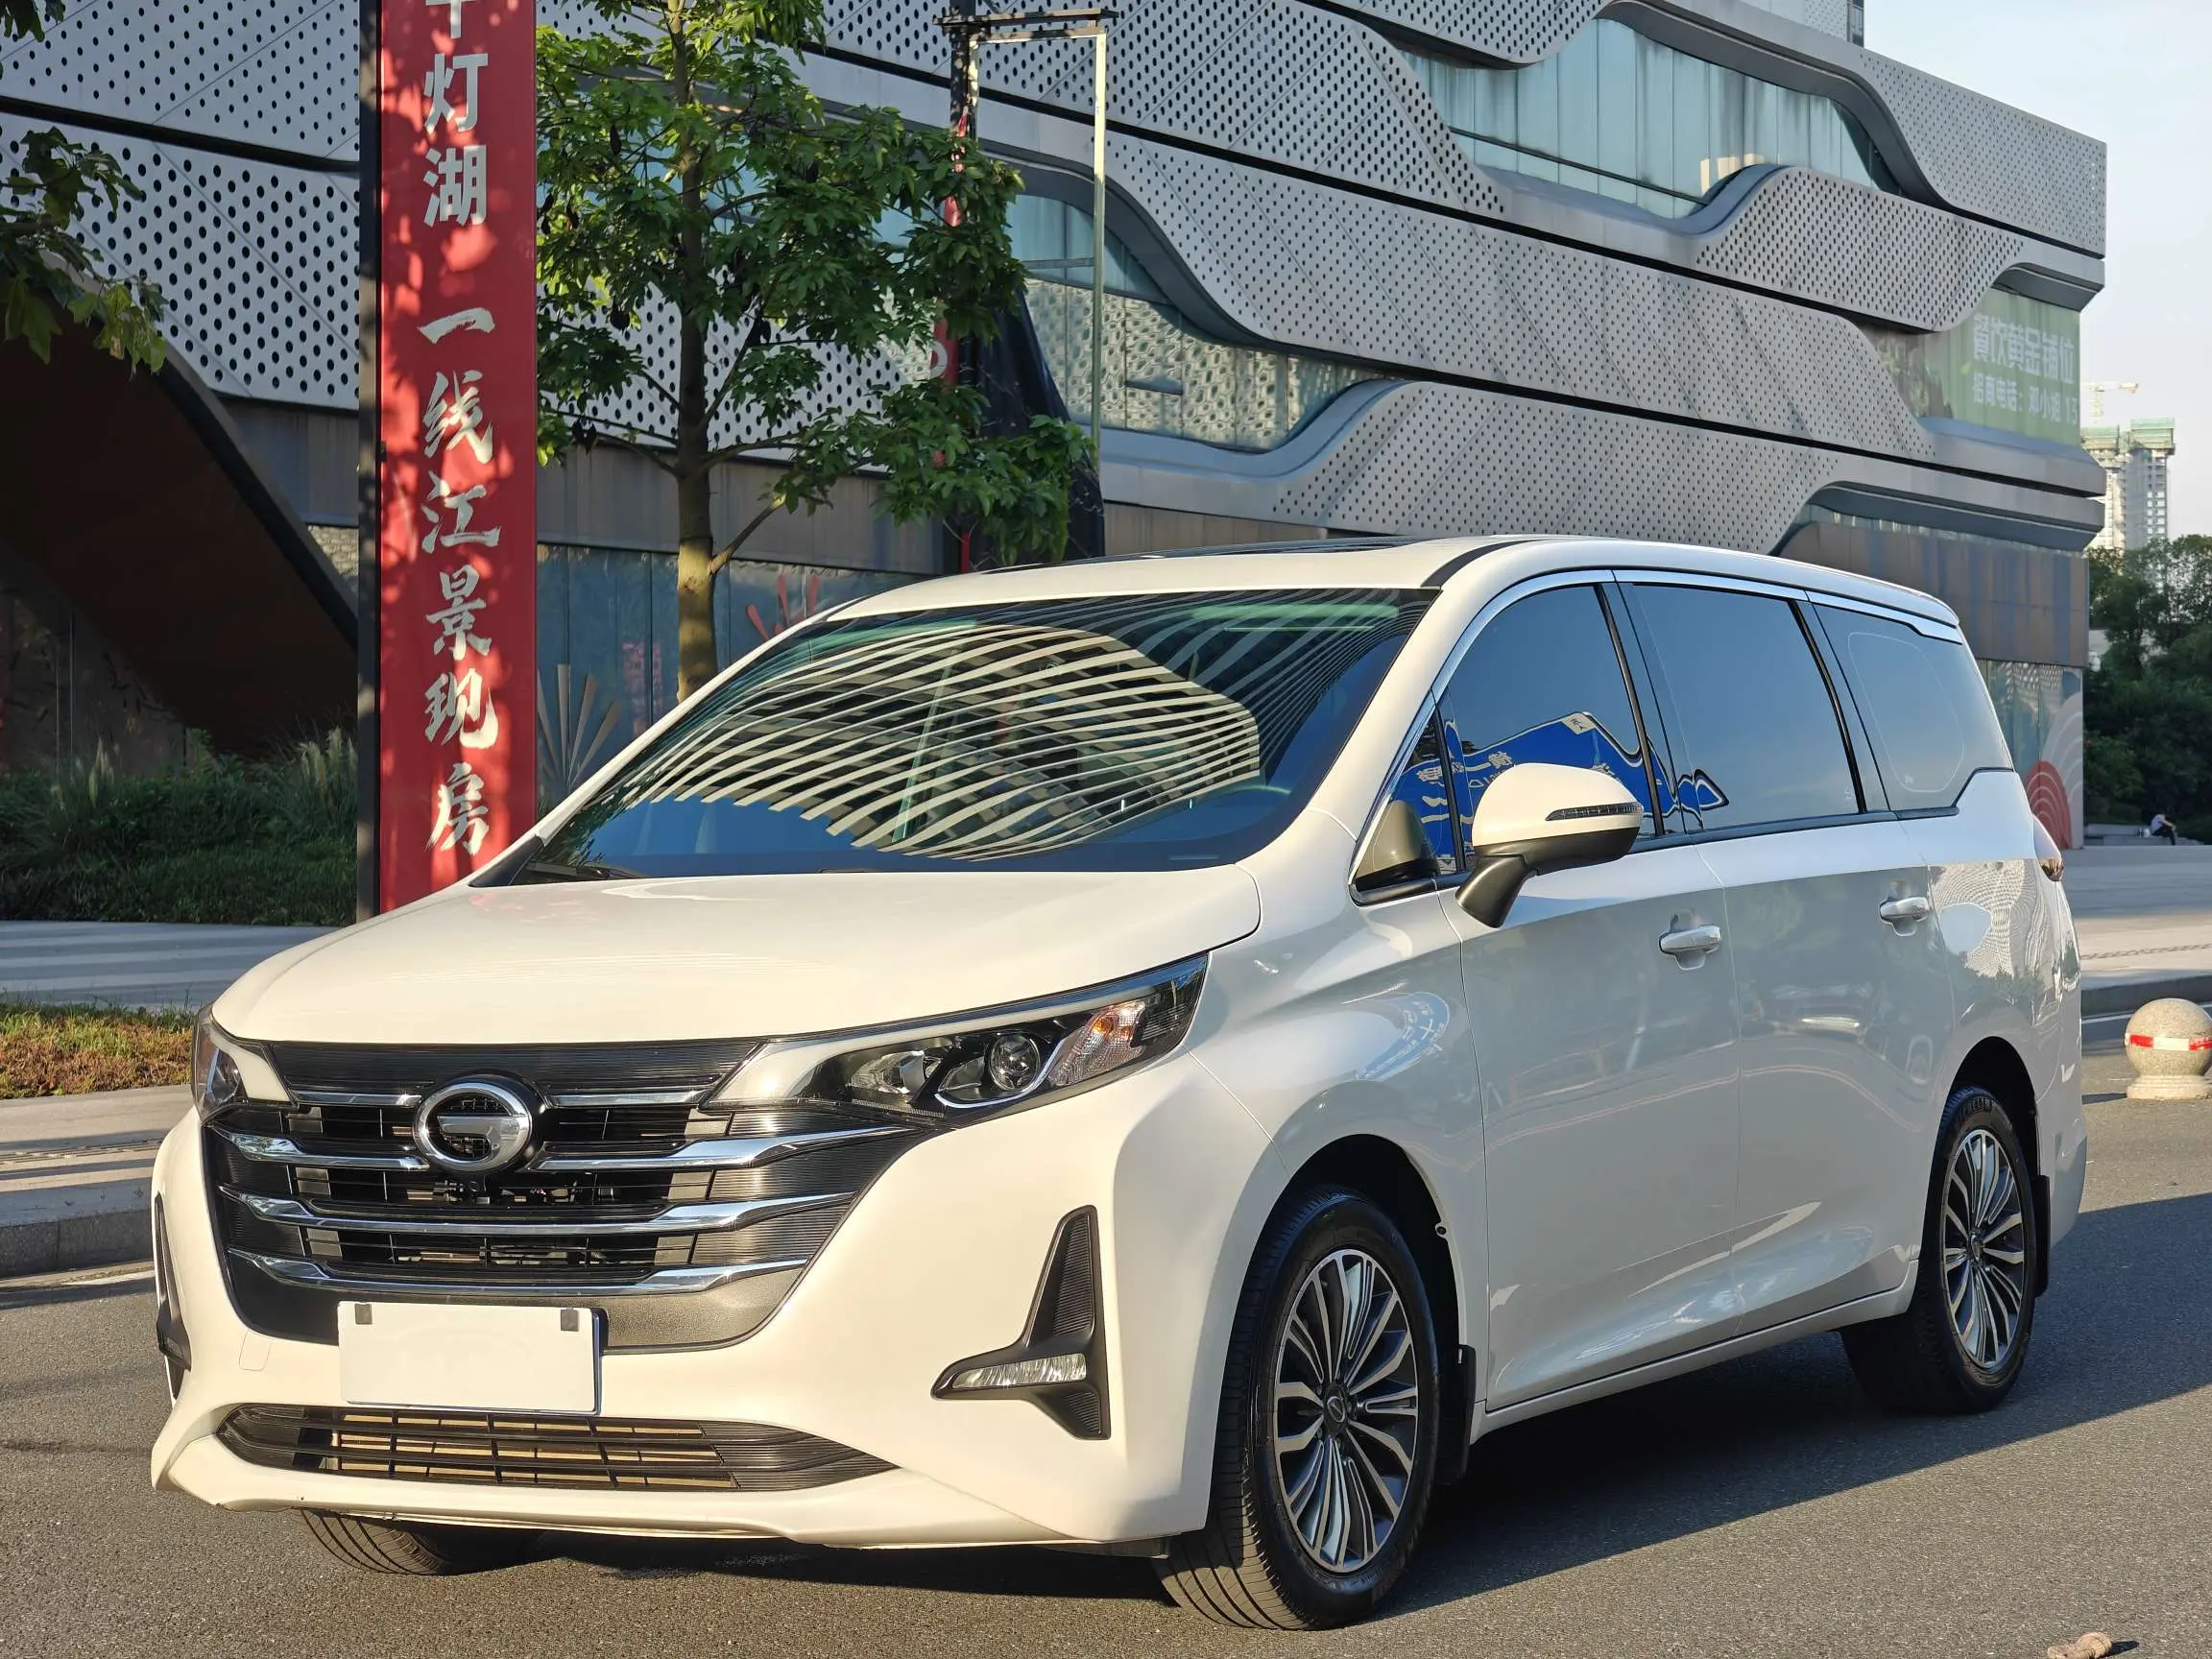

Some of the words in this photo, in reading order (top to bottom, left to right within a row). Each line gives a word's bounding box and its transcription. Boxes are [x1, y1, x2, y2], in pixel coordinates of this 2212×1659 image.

[417, 307, 501, 855] 一线江景现房
